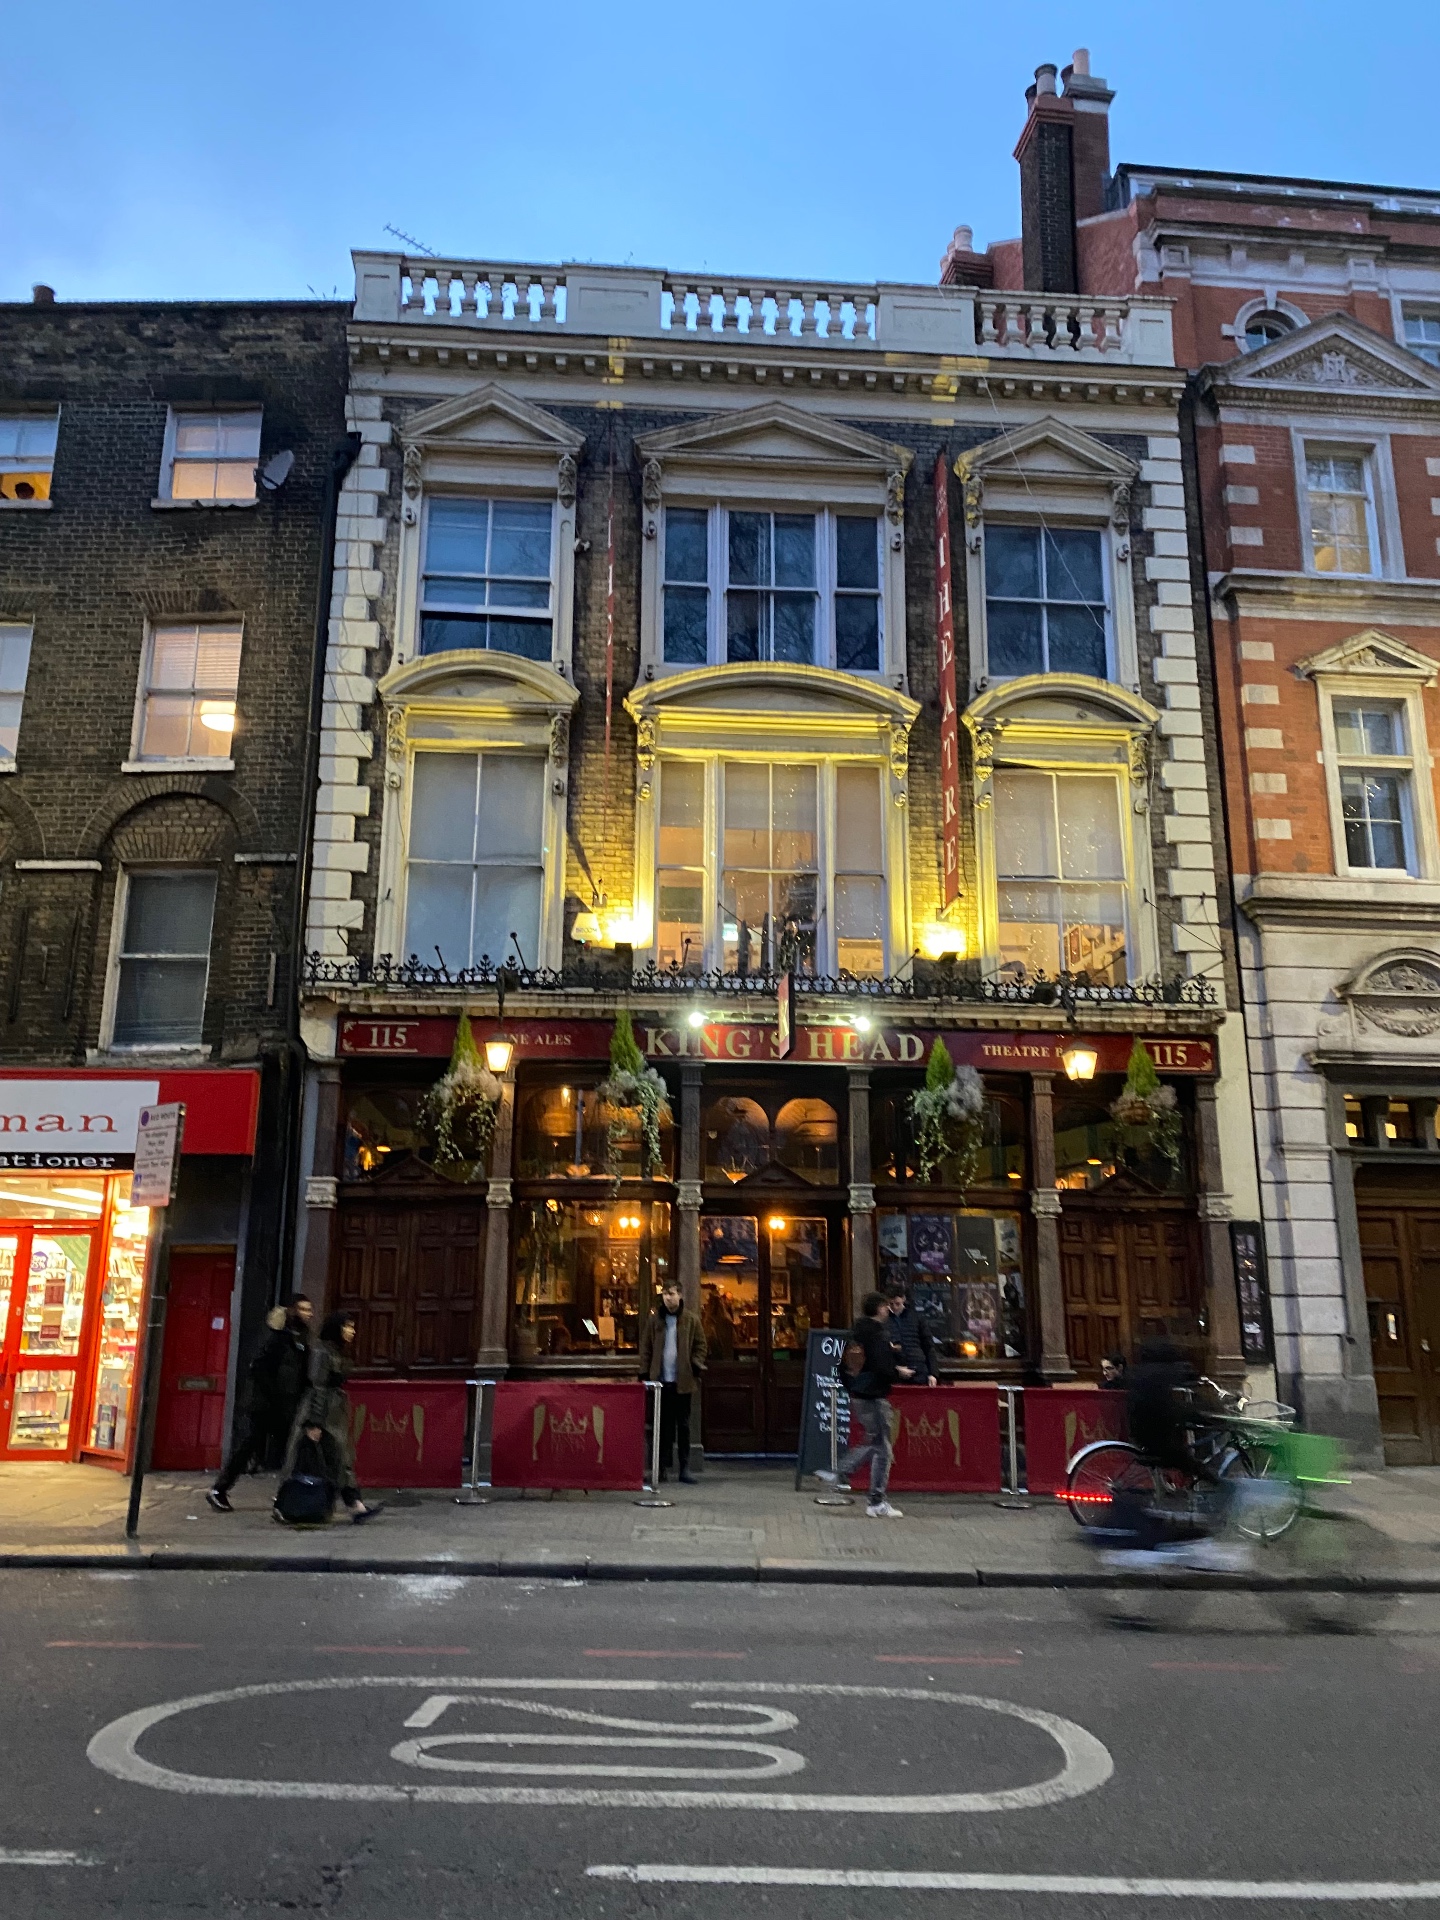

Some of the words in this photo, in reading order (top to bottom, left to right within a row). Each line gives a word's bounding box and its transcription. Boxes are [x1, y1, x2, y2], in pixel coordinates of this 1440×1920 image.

[369, 1026, 408, 1048] 115
[534, 1033, 572, 1046] ALES
[644, 1026, 781, 1059] KING'S
[807, 1029, 926, 1062] HEAD
[982, 1044, 1051, 1058] THEATRE
[1152, 1045, 1188, 1066] 115
[0, 1114, 119, 1133] man
[0, 1153, 116, 1168] ationer
[390, 1693, 808, 1780] 20
